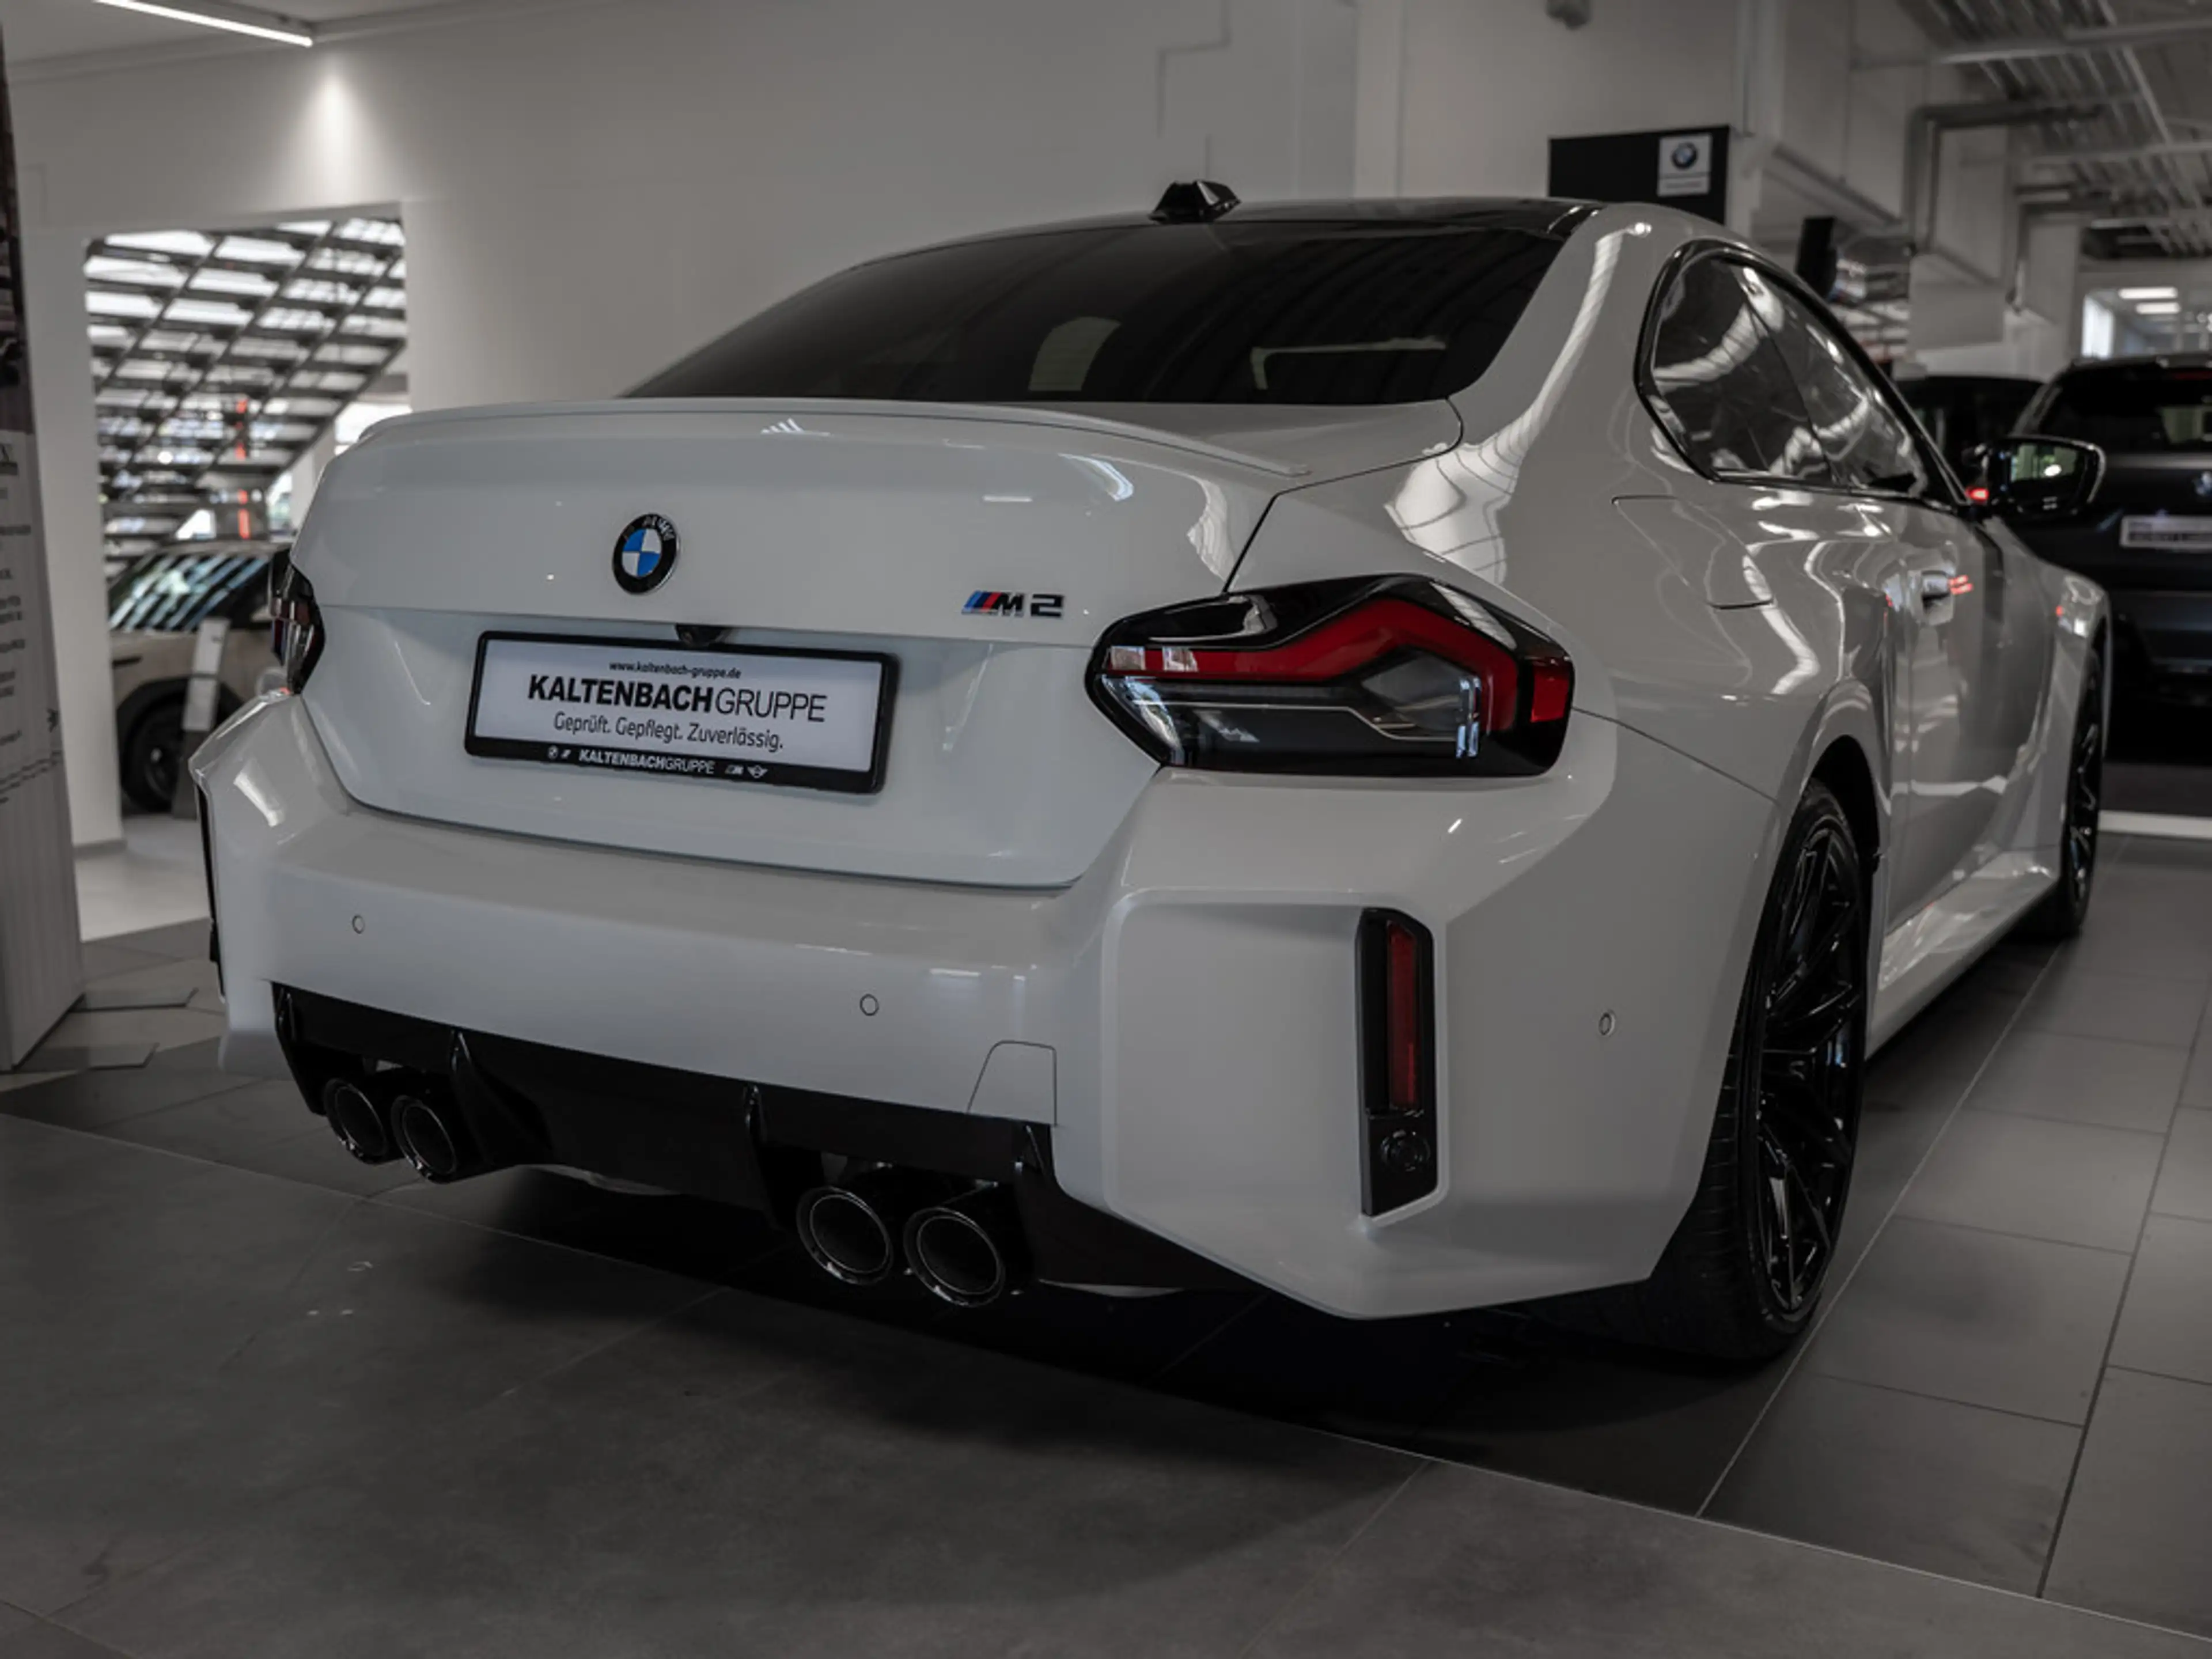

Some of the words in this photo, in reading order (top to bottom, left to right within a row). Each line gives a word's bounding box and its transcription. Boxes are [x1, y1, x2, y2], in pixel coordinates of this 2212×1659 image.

[976, 590, 1065, 618] M2
[609, 662, 742, 679] www.kaltenbach-gruppe.de
[554, 711, 611, 735] Geprüft.
[615, 717, 683, 744] Gepflegt.
[687, 722, 783, 753] Zuverlässig.
